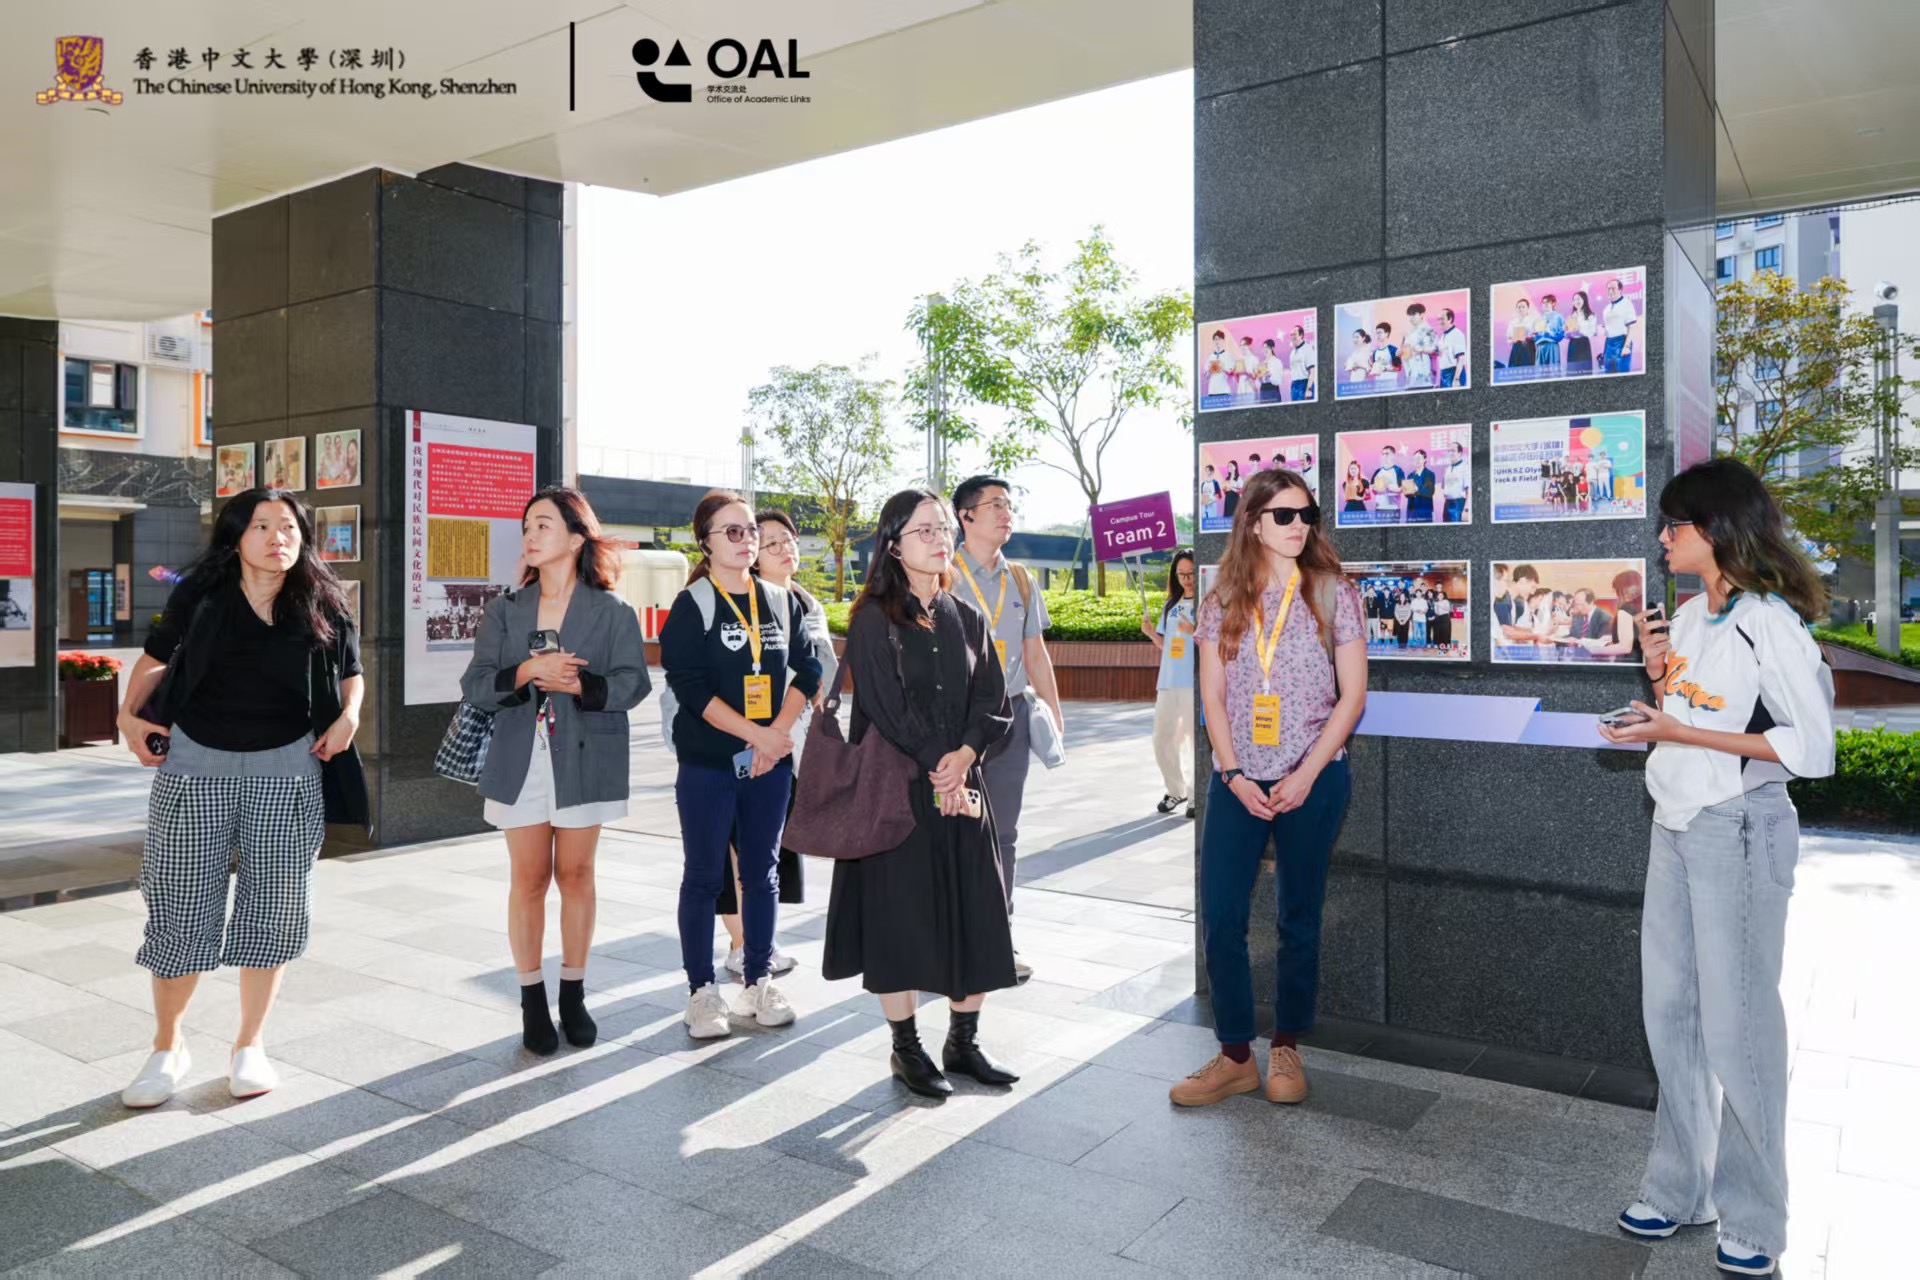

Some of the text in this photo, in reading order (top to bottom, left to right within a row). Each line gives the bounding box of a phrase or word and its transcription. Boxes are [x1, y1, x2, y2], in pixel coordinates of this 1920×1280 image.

[1110, 511, 1155, 525] Campus Tour
[1103, 520, 1167, 547] Team 2
